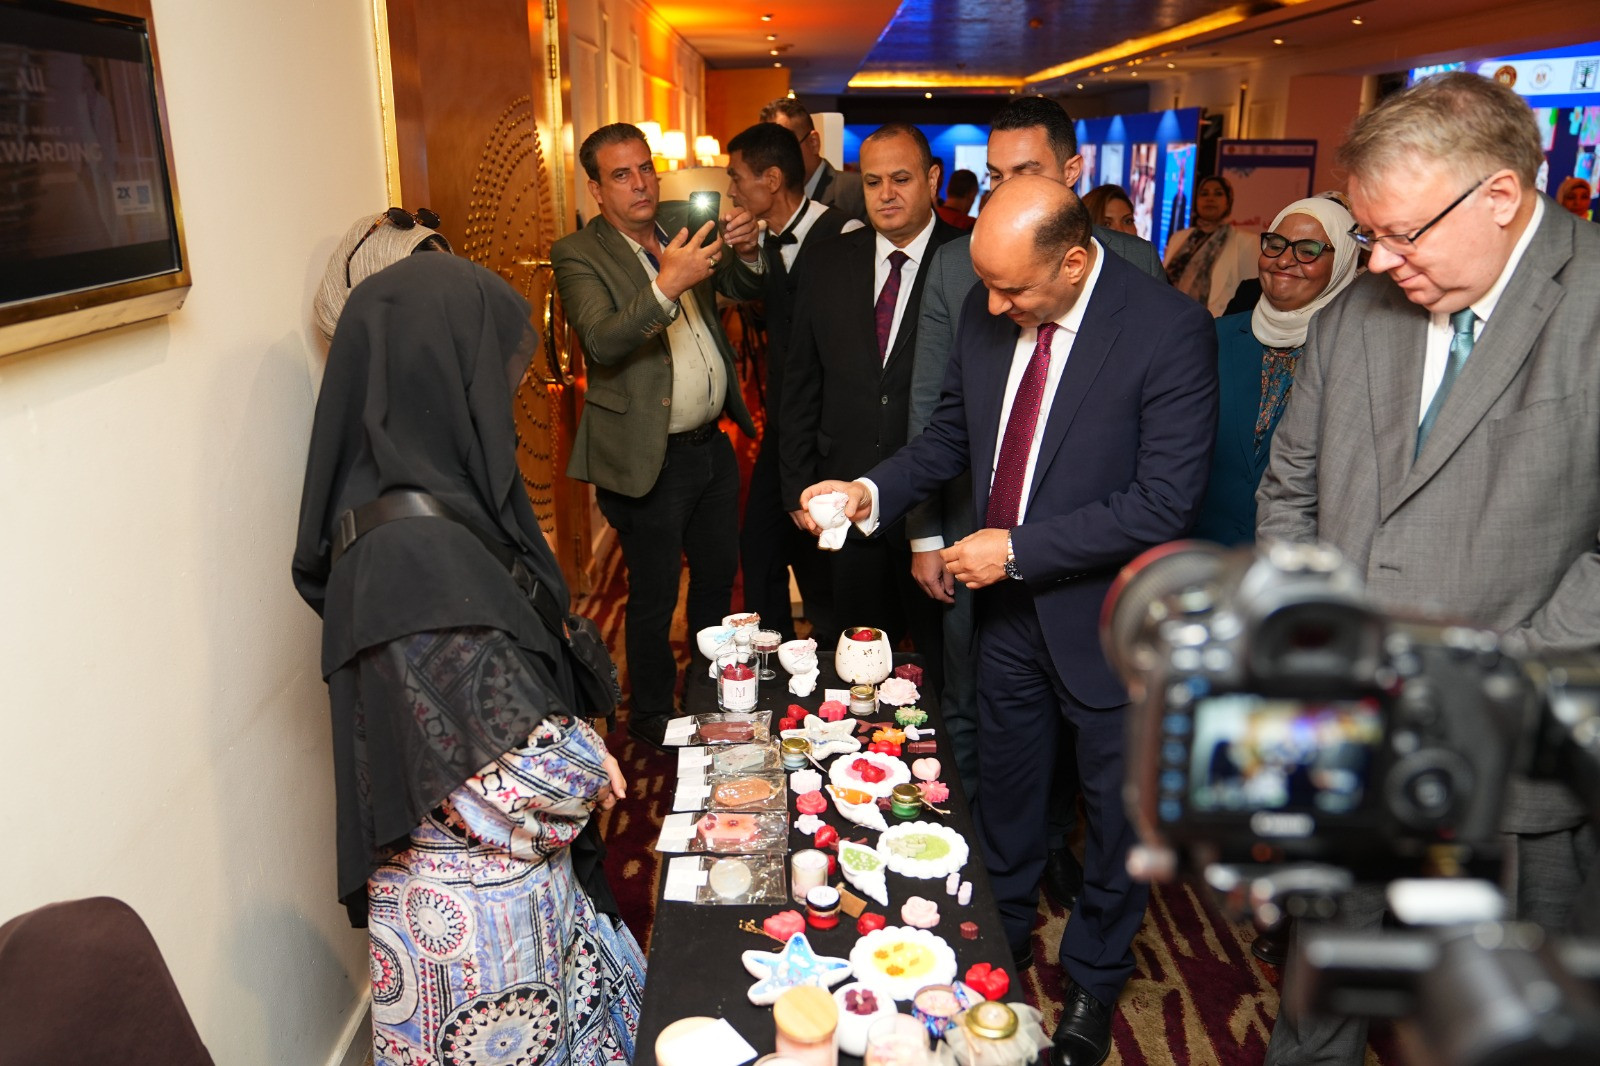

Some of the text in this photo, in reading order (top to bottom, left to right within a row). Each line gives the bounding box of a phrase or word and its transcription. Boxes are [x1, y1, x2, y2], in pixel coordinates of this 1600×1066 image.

[0, 141, 103, 163] WARDING
[116, 186, 131, 199] 2X
[735, 687, 746, 698] M
